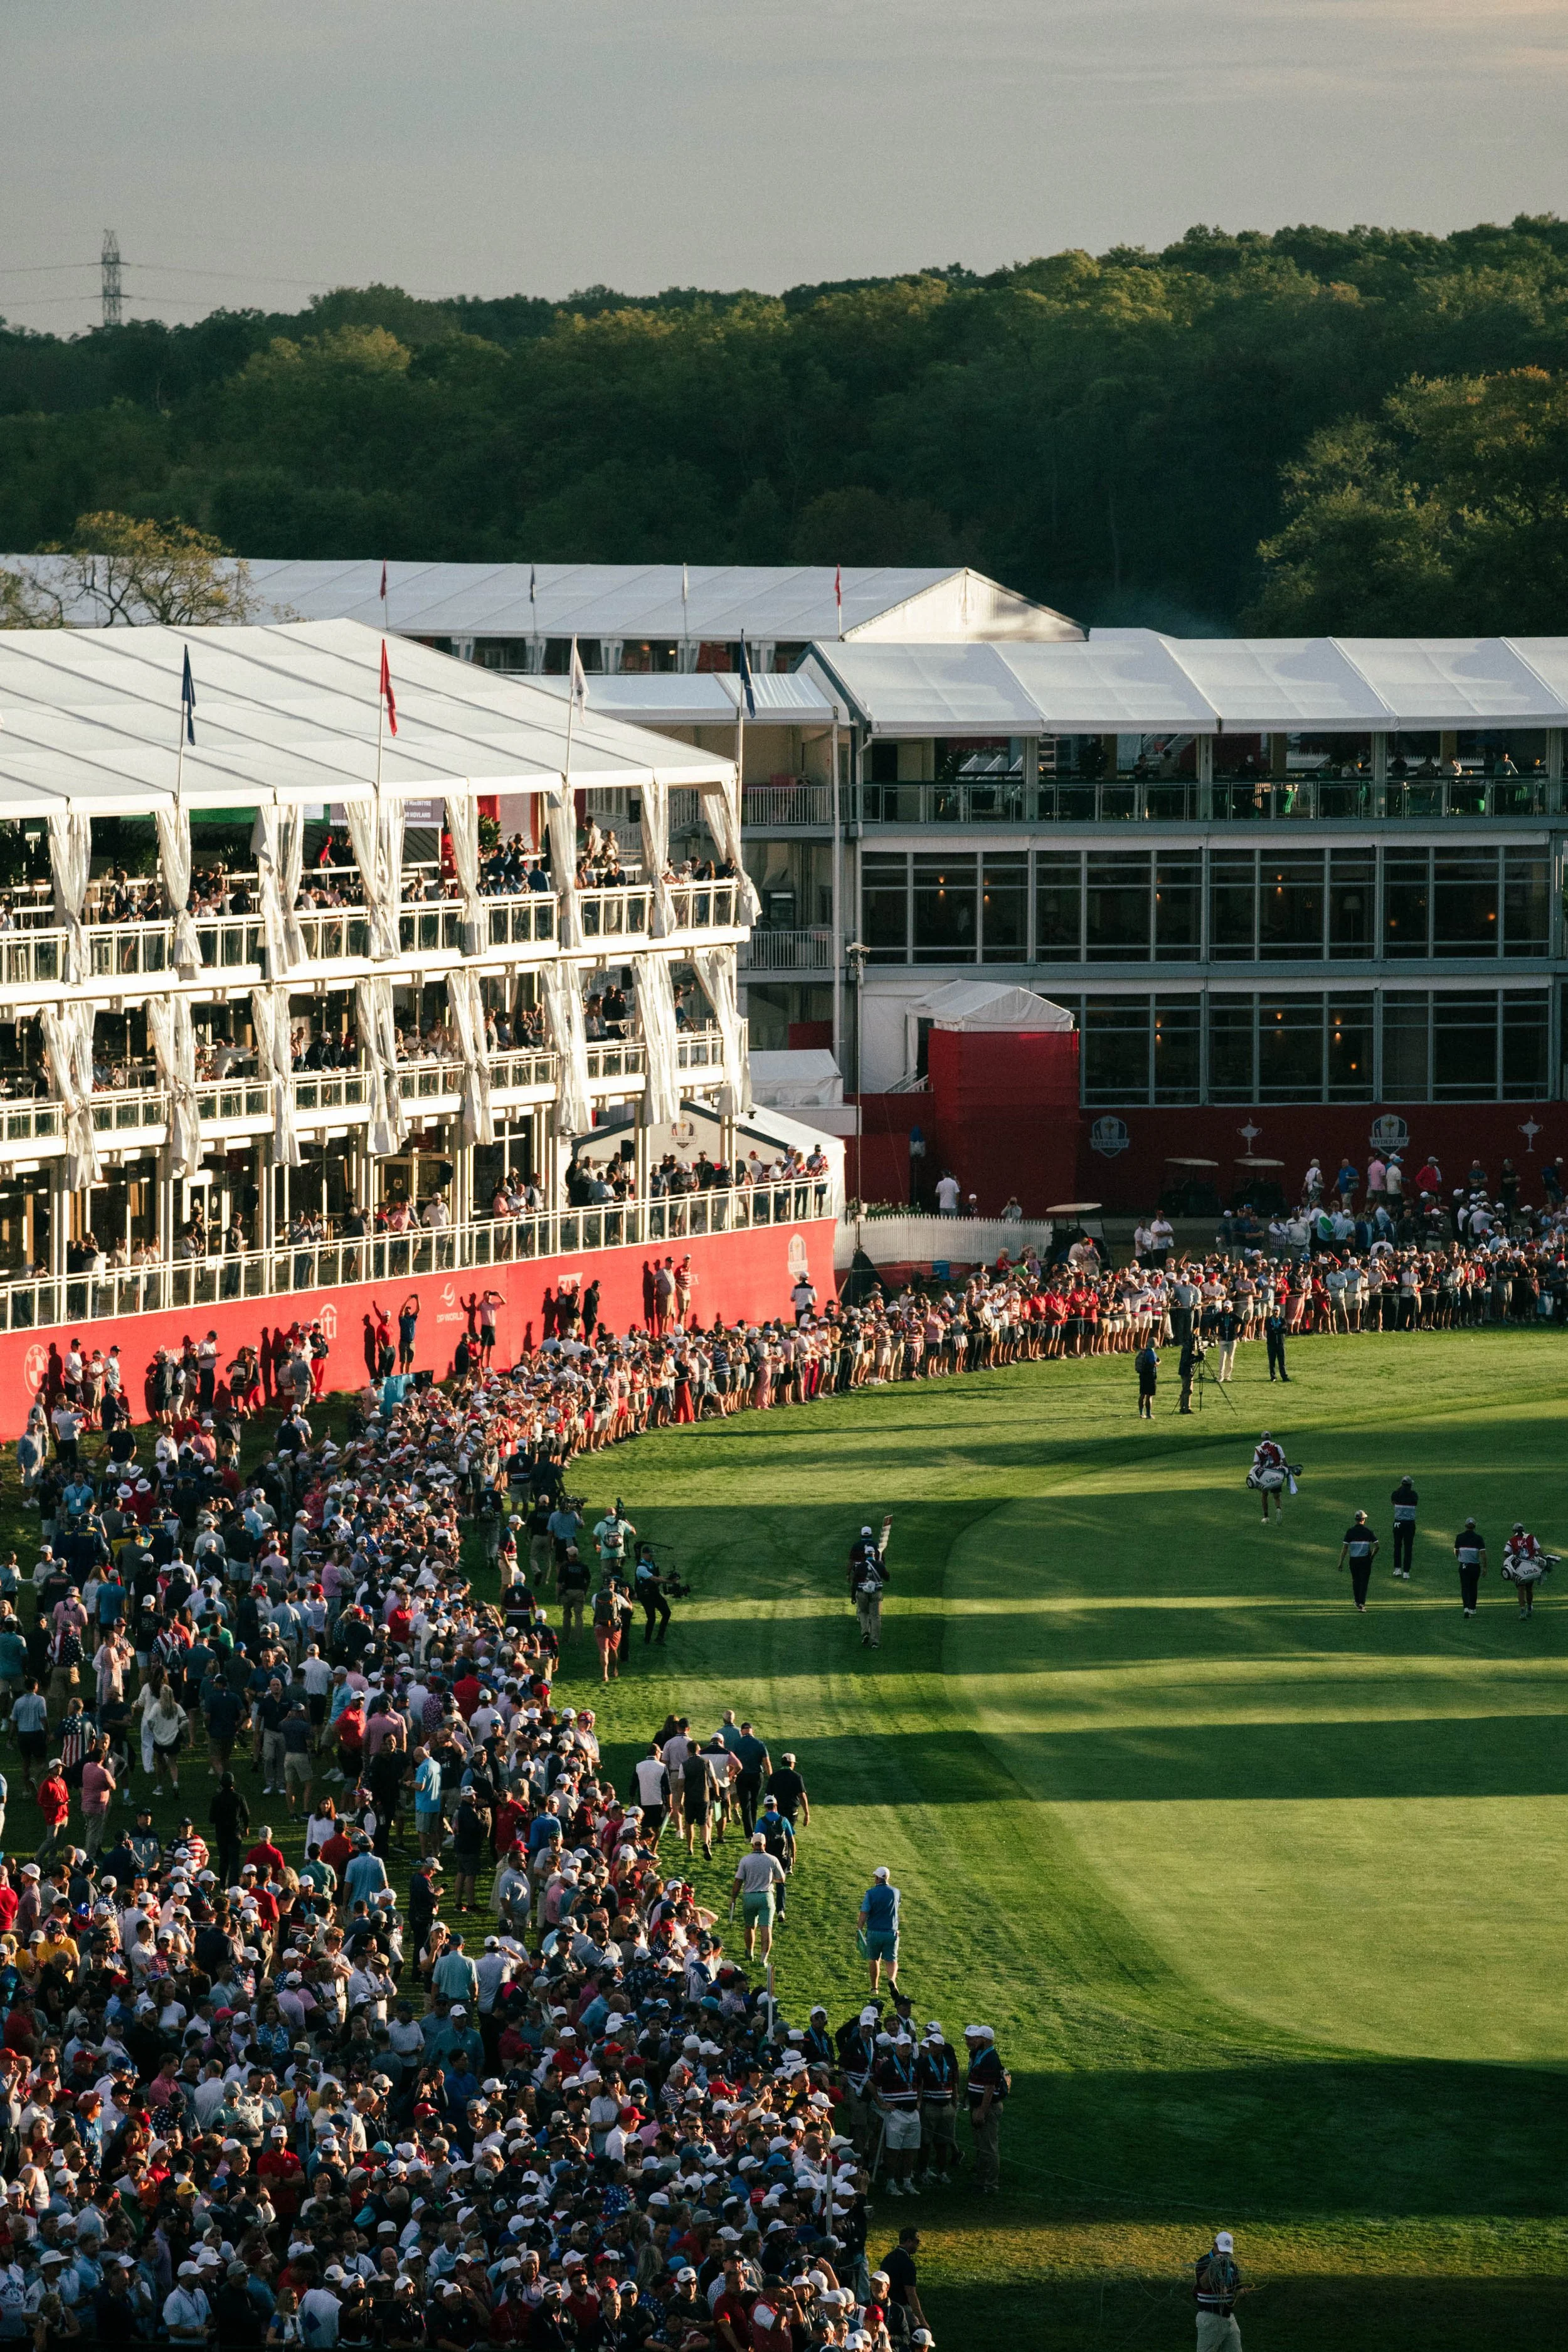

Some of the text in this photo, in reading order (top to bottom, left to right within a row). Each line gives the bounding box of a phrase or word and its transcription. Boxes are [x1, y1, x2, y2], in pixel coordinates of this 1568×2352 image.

[437, 1311, 464, 1323] DP WORLD
[509, 2080, 519, 2090] 74
